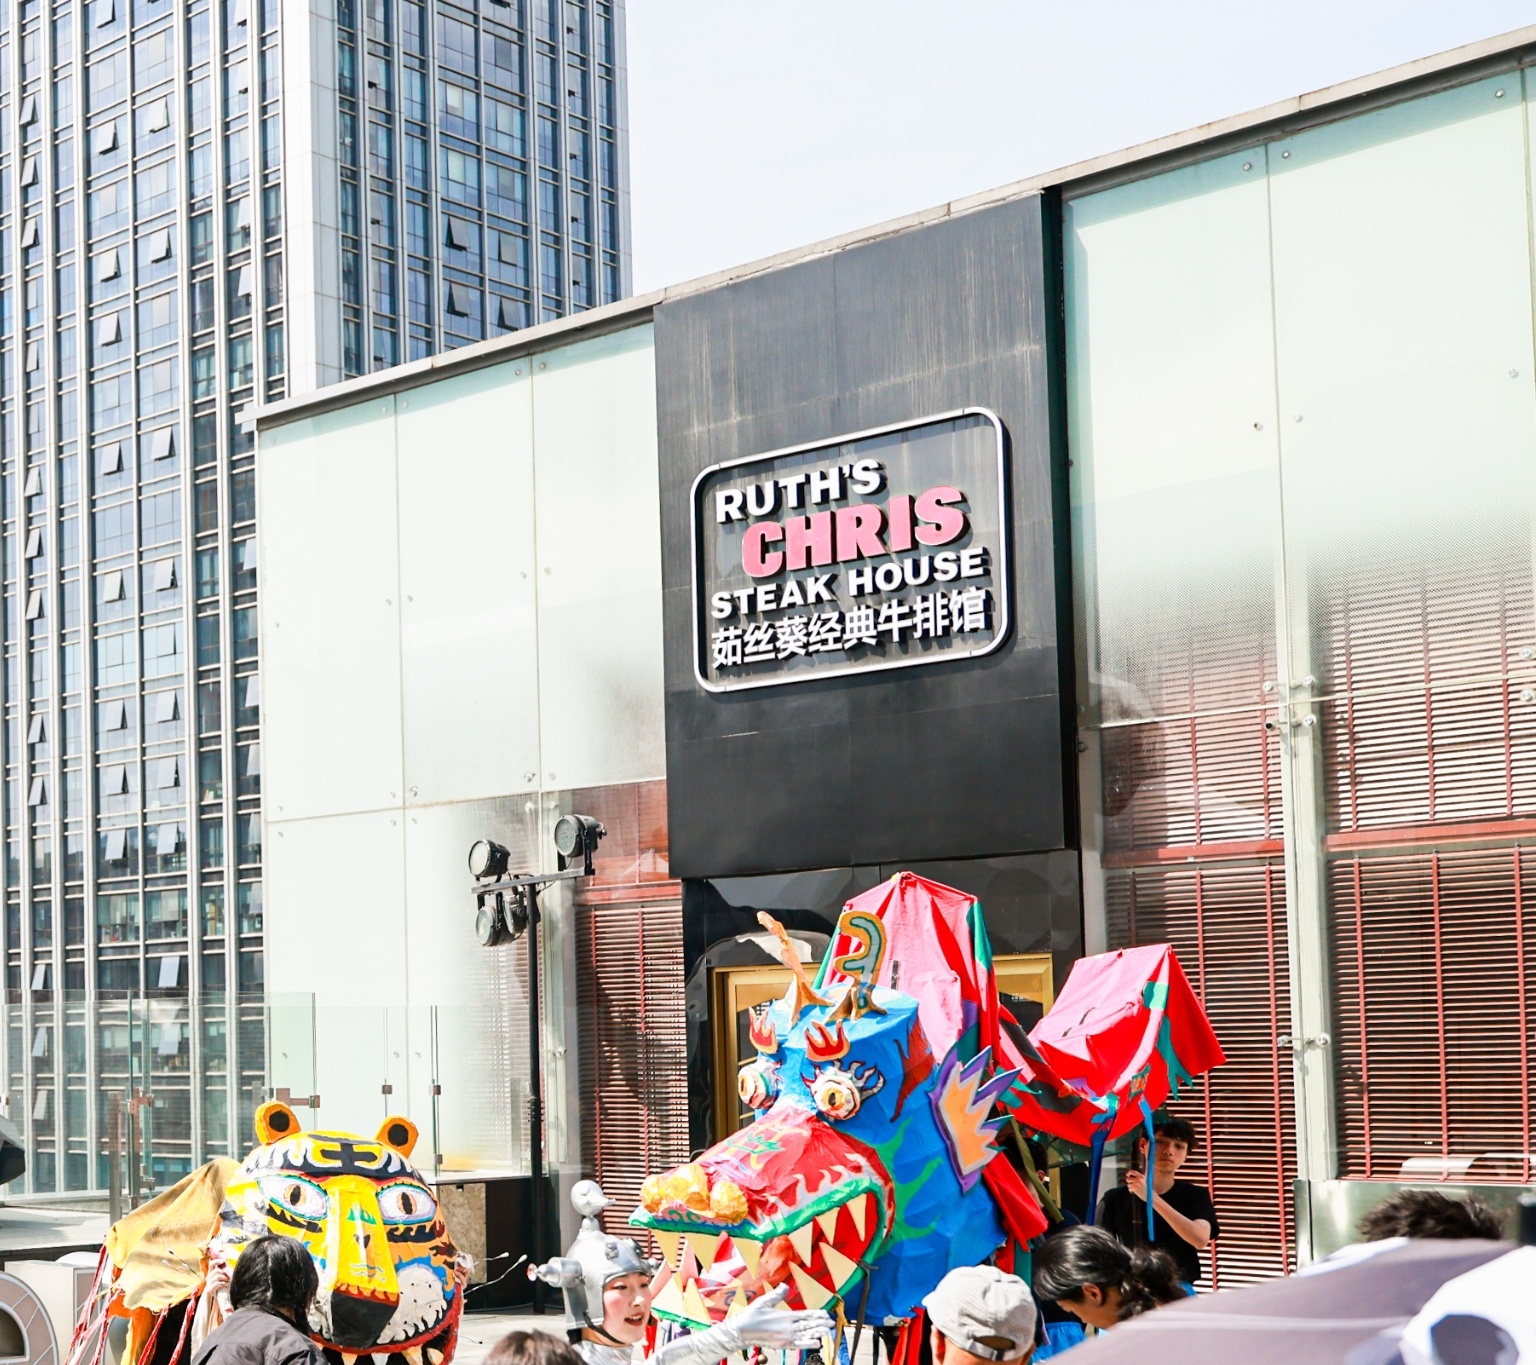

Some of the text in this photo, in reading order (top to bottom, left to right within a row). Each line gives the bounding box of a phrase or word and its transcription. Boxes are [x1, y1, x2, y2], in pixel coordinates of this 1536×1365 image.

[715, 459, 883, 523] RUTH'S
[741, 485, 965, 578] CHRIS
[711, 547, 986, 619] STEAK HOUSE
[711, 586, 987, 669] 茹丝葵经典牛排馆
